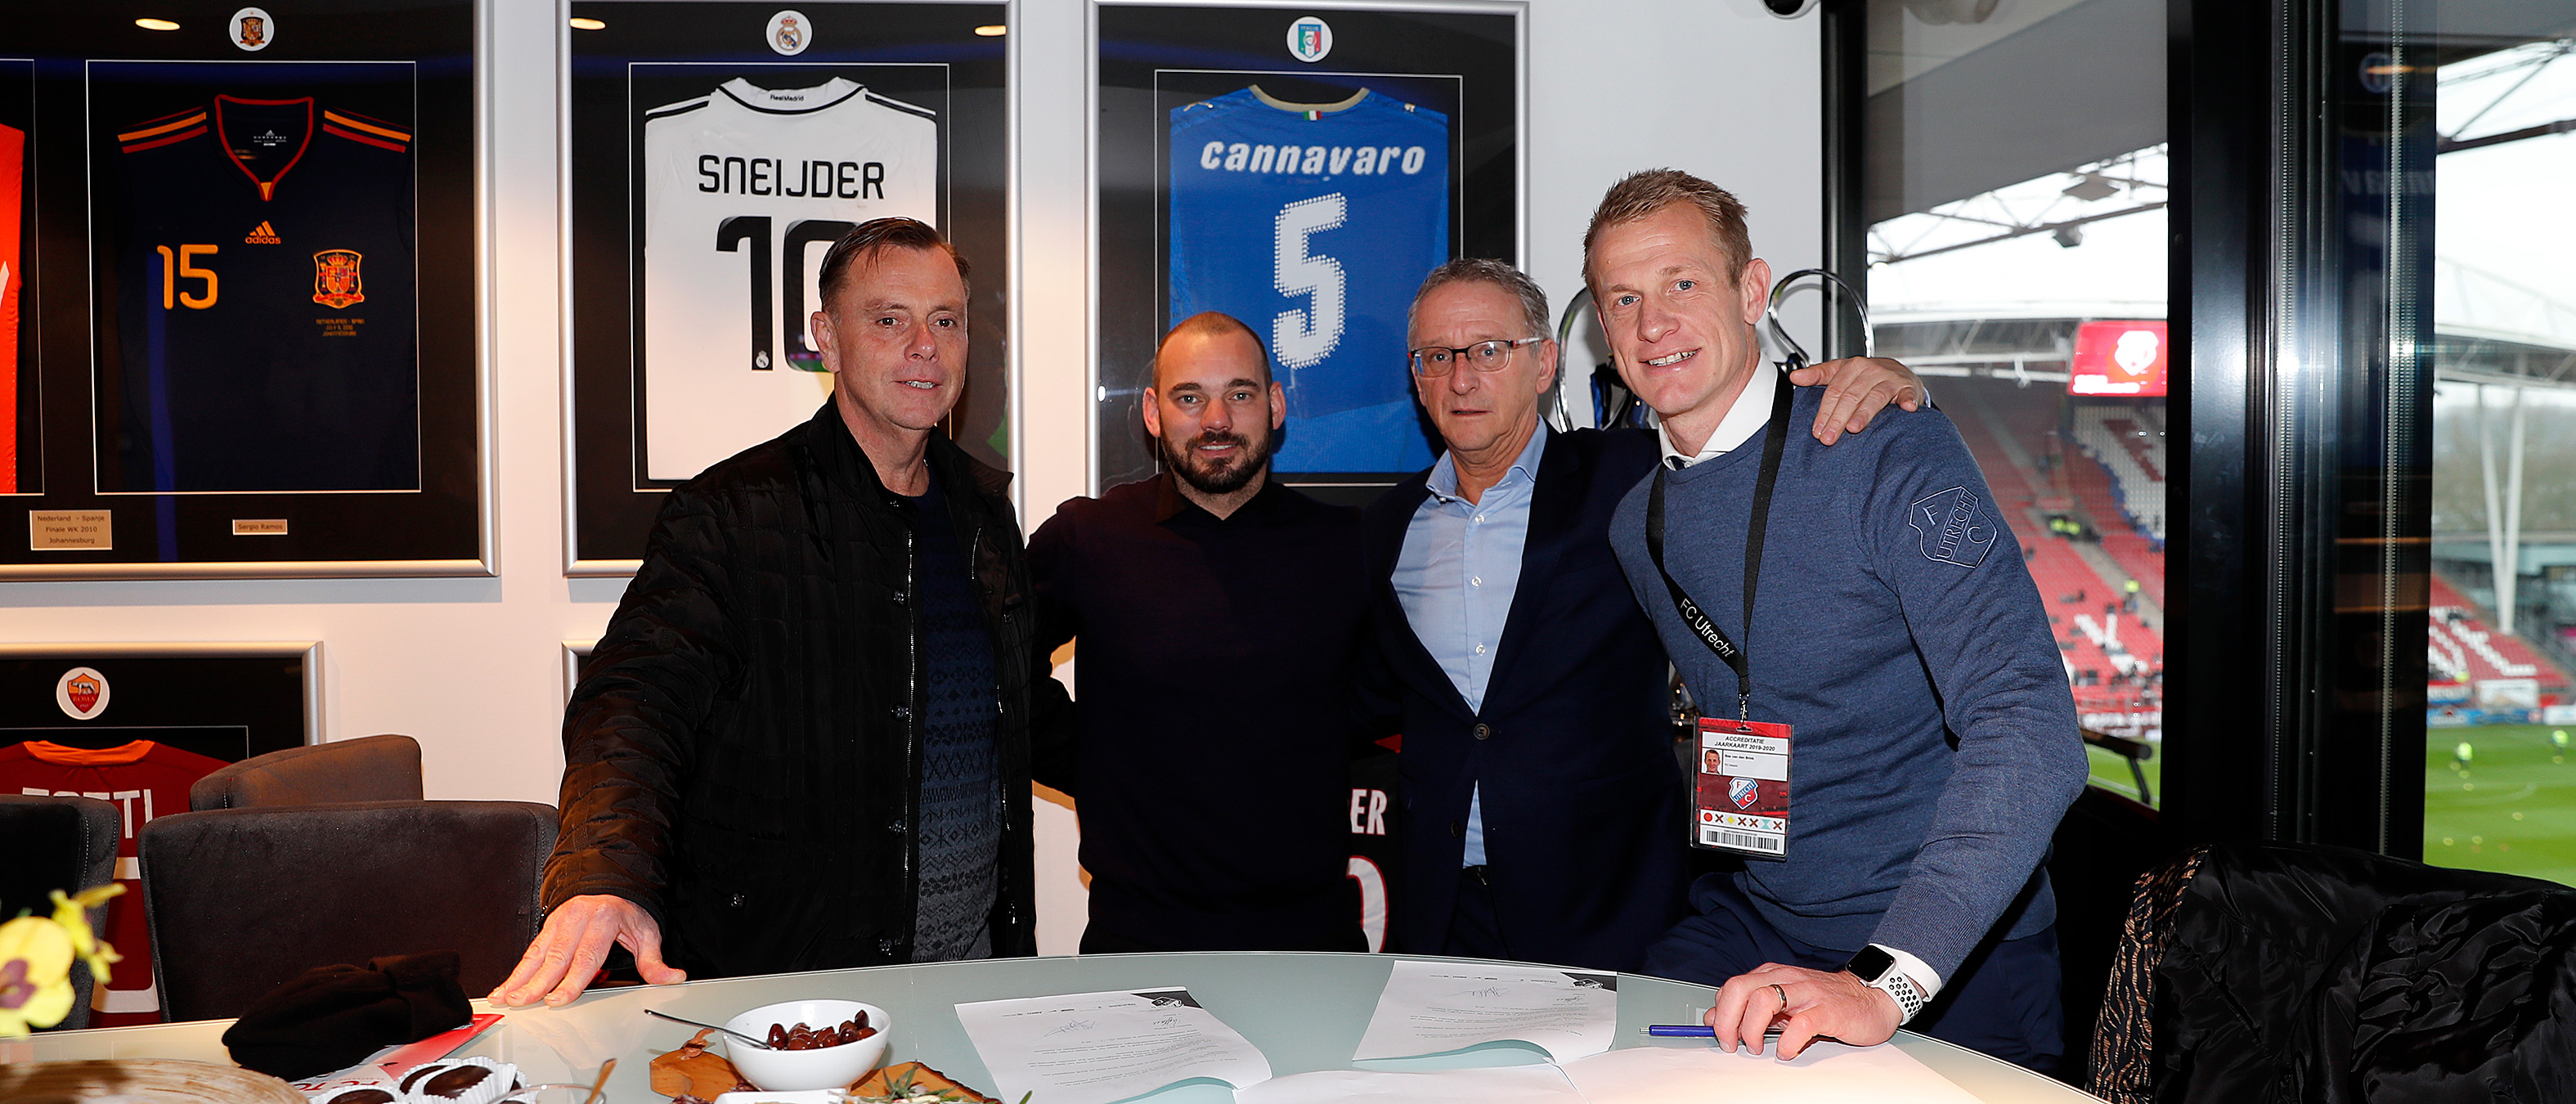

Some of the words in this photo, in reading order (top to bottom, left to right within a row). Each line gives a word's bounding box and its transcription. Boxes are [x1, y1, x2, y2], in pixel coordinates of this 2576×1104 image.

[1200, 141, 1426, 175] cannavaro
[698, 155, 885, 200] SNEIJDER
[245, 235, 281, 245] adidas
[157, 244, 218, 310] 15
[1272, 192, 1347, 370] 5
[1923, 504, 1938, 526] F
[1936, 491, 1976, 559] UTRECHT
[1967, 526, 1988, 544] C
[1680, 598, 1697, 619] FC
[1694, 616, 1735, 657] Utrecht
[1725, 736, 1765, 744] ACCREDITATIE
[1744, 794, 1752, 802] C
